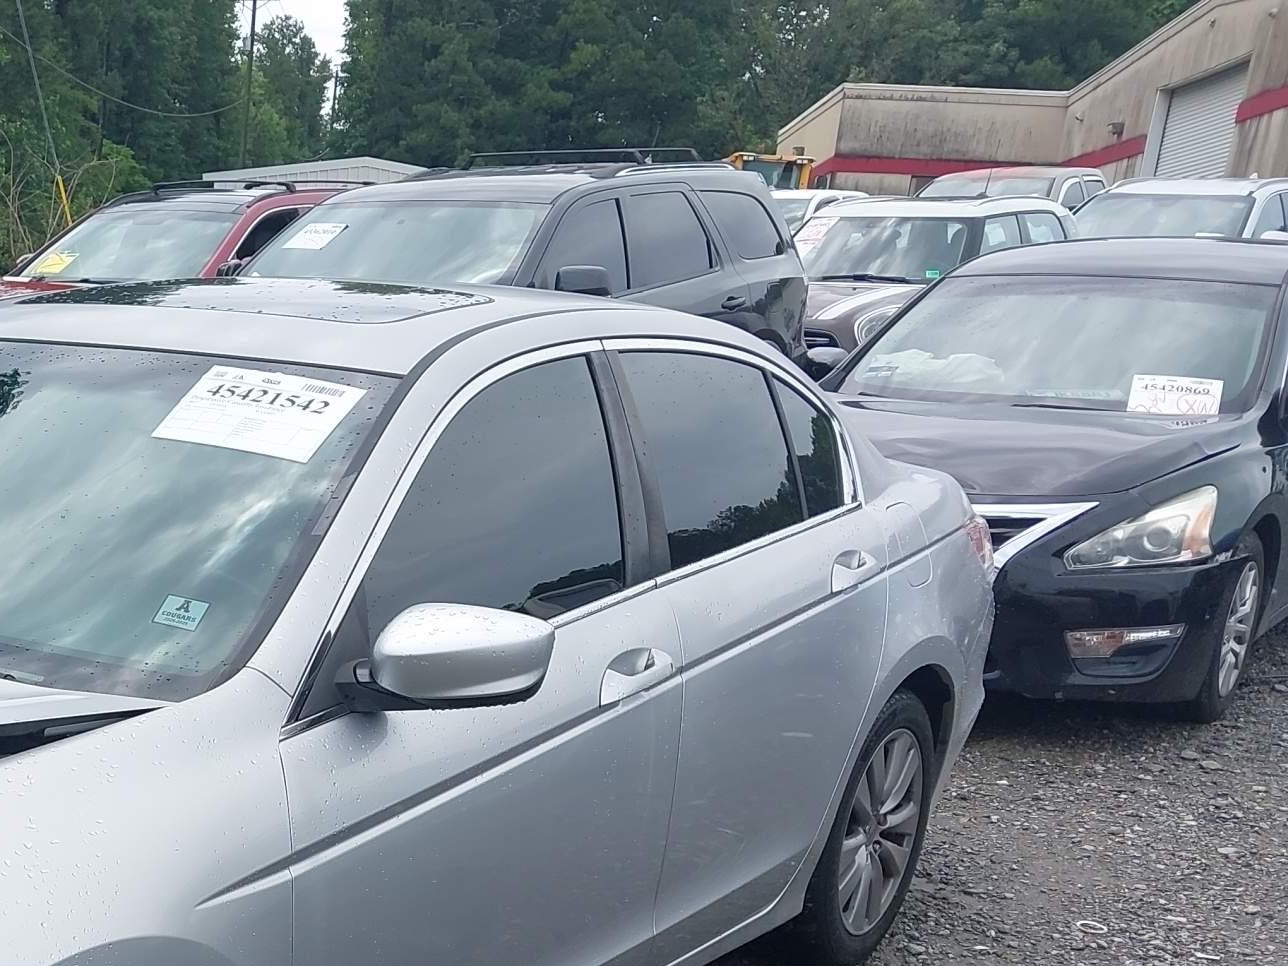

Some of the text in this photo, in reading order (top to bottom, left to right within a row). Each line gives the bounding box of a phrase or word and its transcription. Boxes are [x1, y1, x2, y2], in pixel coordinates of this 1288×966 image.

[1141, 383, 1210, 396] 45420869
[206, 383, 331, 415] 45421542
[175, 599, 193, 613] A
[161, 610, 198, 623] COUGARS
